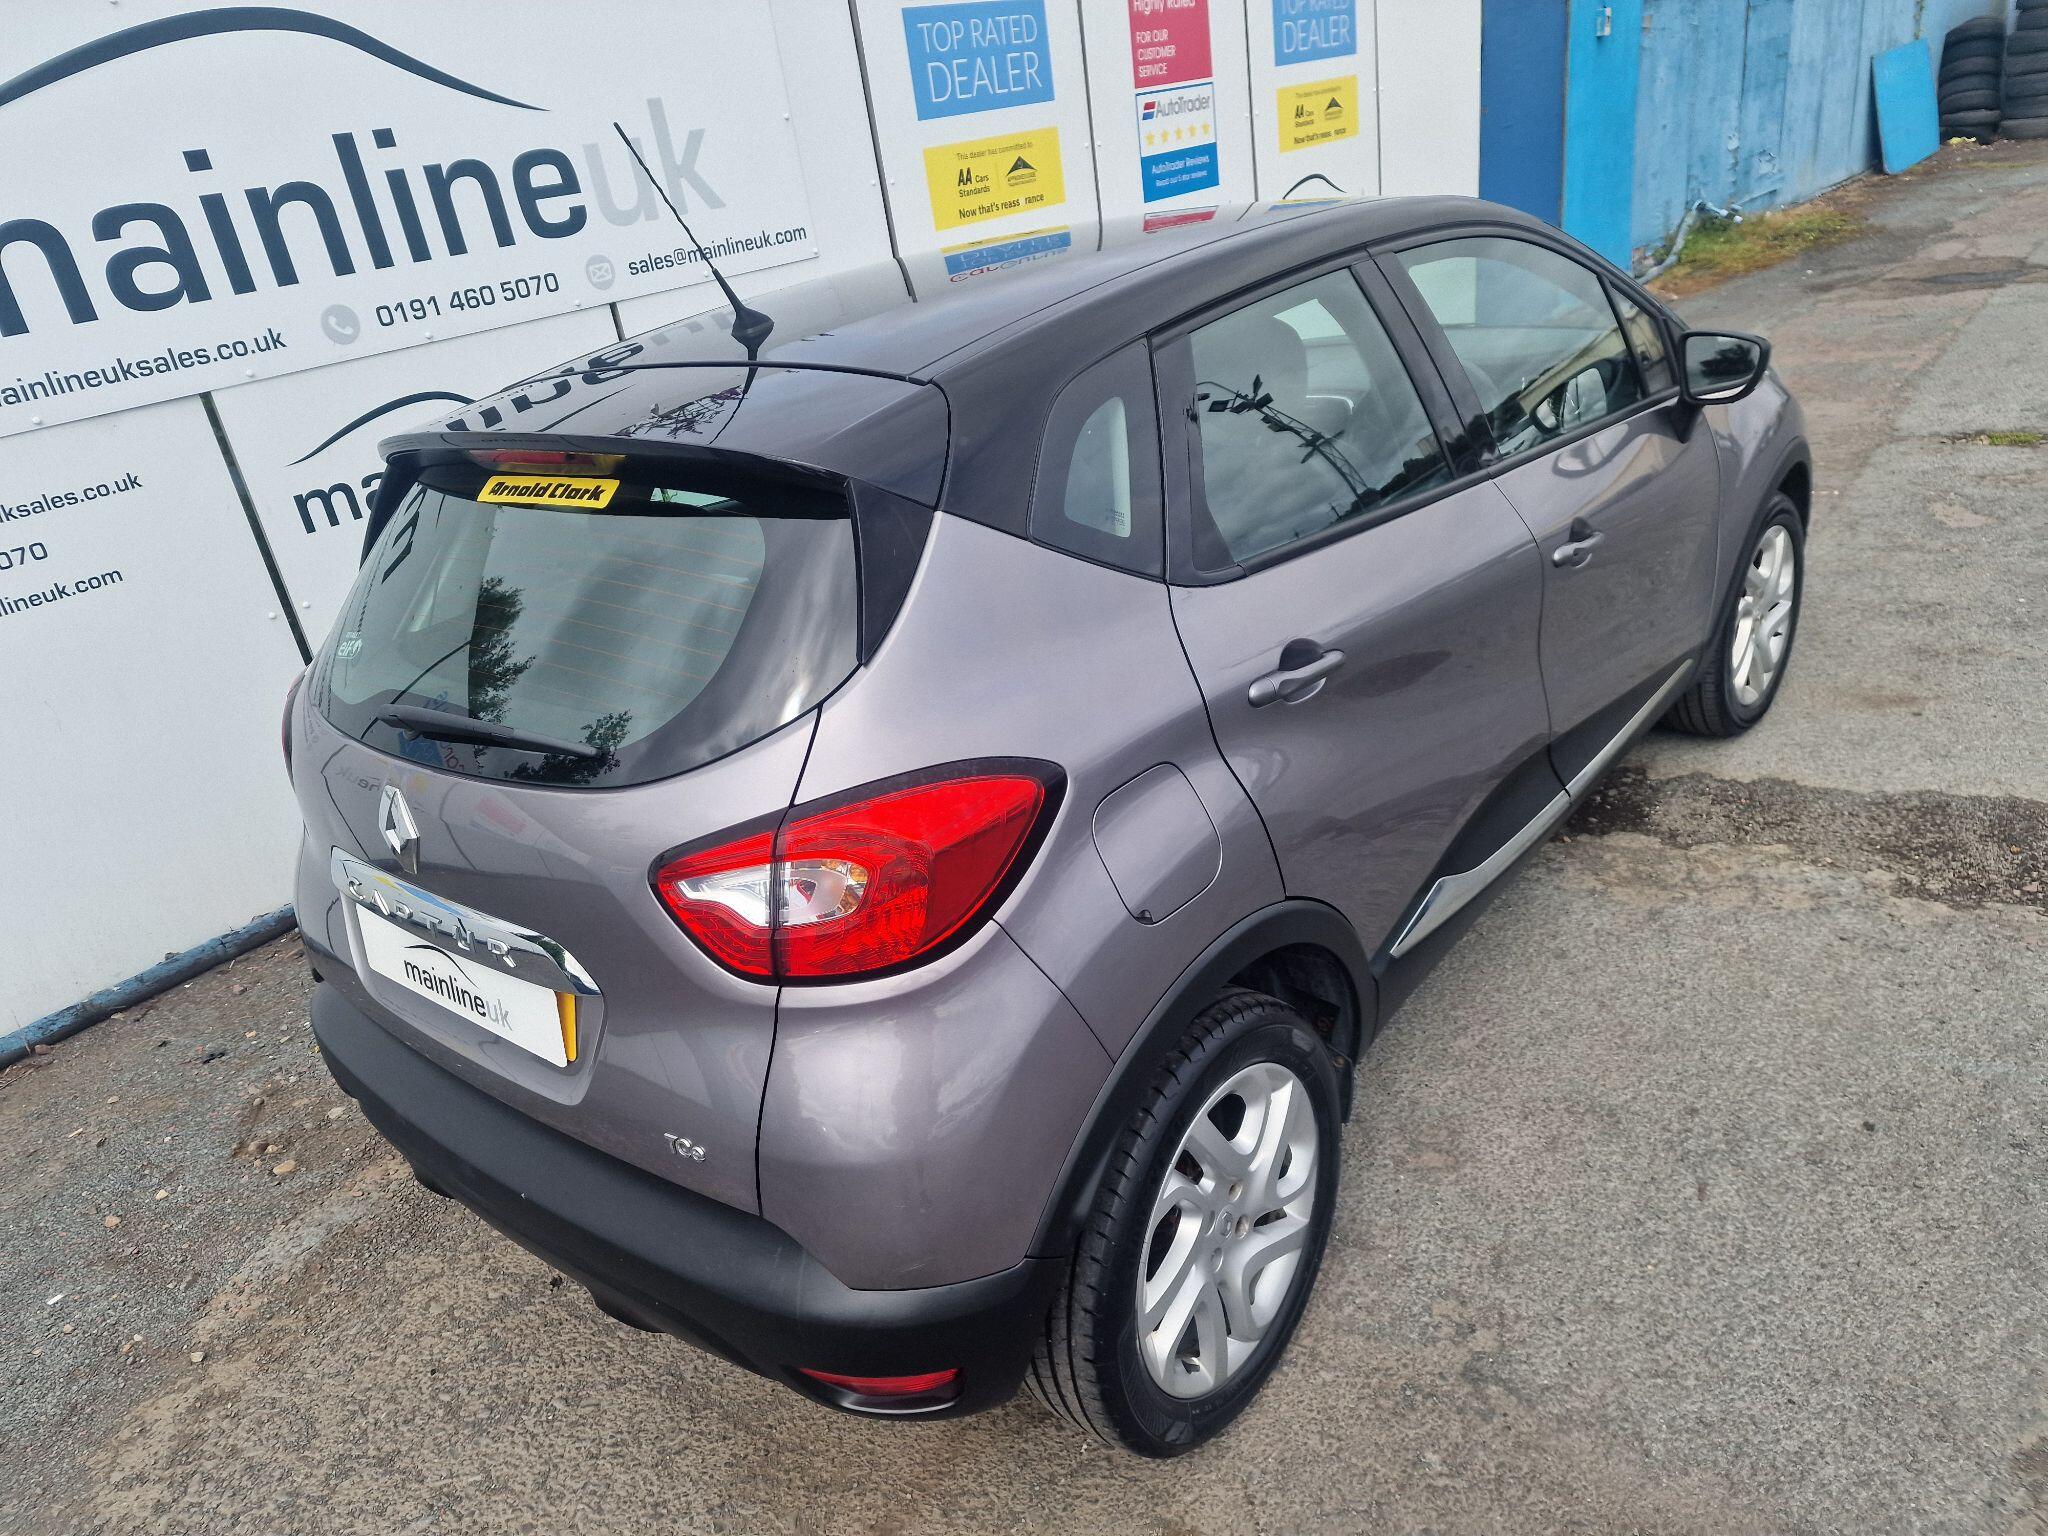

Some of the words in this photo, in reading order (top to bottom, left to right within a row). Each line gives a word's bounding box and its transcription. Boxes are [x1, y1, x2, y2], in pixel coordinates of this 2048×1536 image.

[917, 21, 964, 53] TOP
[970, 14, 1038, 48] RATED
[1136, 31, 1152, 44] FOR
[1153, 29, 1168, 42] OUR
[1283, 15, 1351, 53] DEALER
[1138, 45, 1176, 60] CUSTOMER
[927, 51, 1043, 103] DEALER
[1138, 63, 1168, 77] SERVICE
[1156, 95, 1210, 118] AutoTrader
[958, 167, 972, 186] AA
[975, 174, 989, 183] Cars
[959, 185, 990, 198] Standards
[959, 208, 977, 220] Now
[978, 202, 1000, 215] that's
[0, 328, 288, 408] ainlineuksales.co.uk
[375, 295, 441, 327] 0191
[450, 285, 496, 311] 460
[500, 272, 560, 302] 5070
[628, 226, 807, 276] sales@mainlineuk.com
[0, 472, 143, 523] ksales.co.uk
[488, 481, 553, 498] Arnold
[547, 482, 606, 501] Clark
[0, 568, 123, 618] lineuk.com
[347, 875, 516, 969] CAPTUR
[403, 959, 513, 1031] mainlineuk
